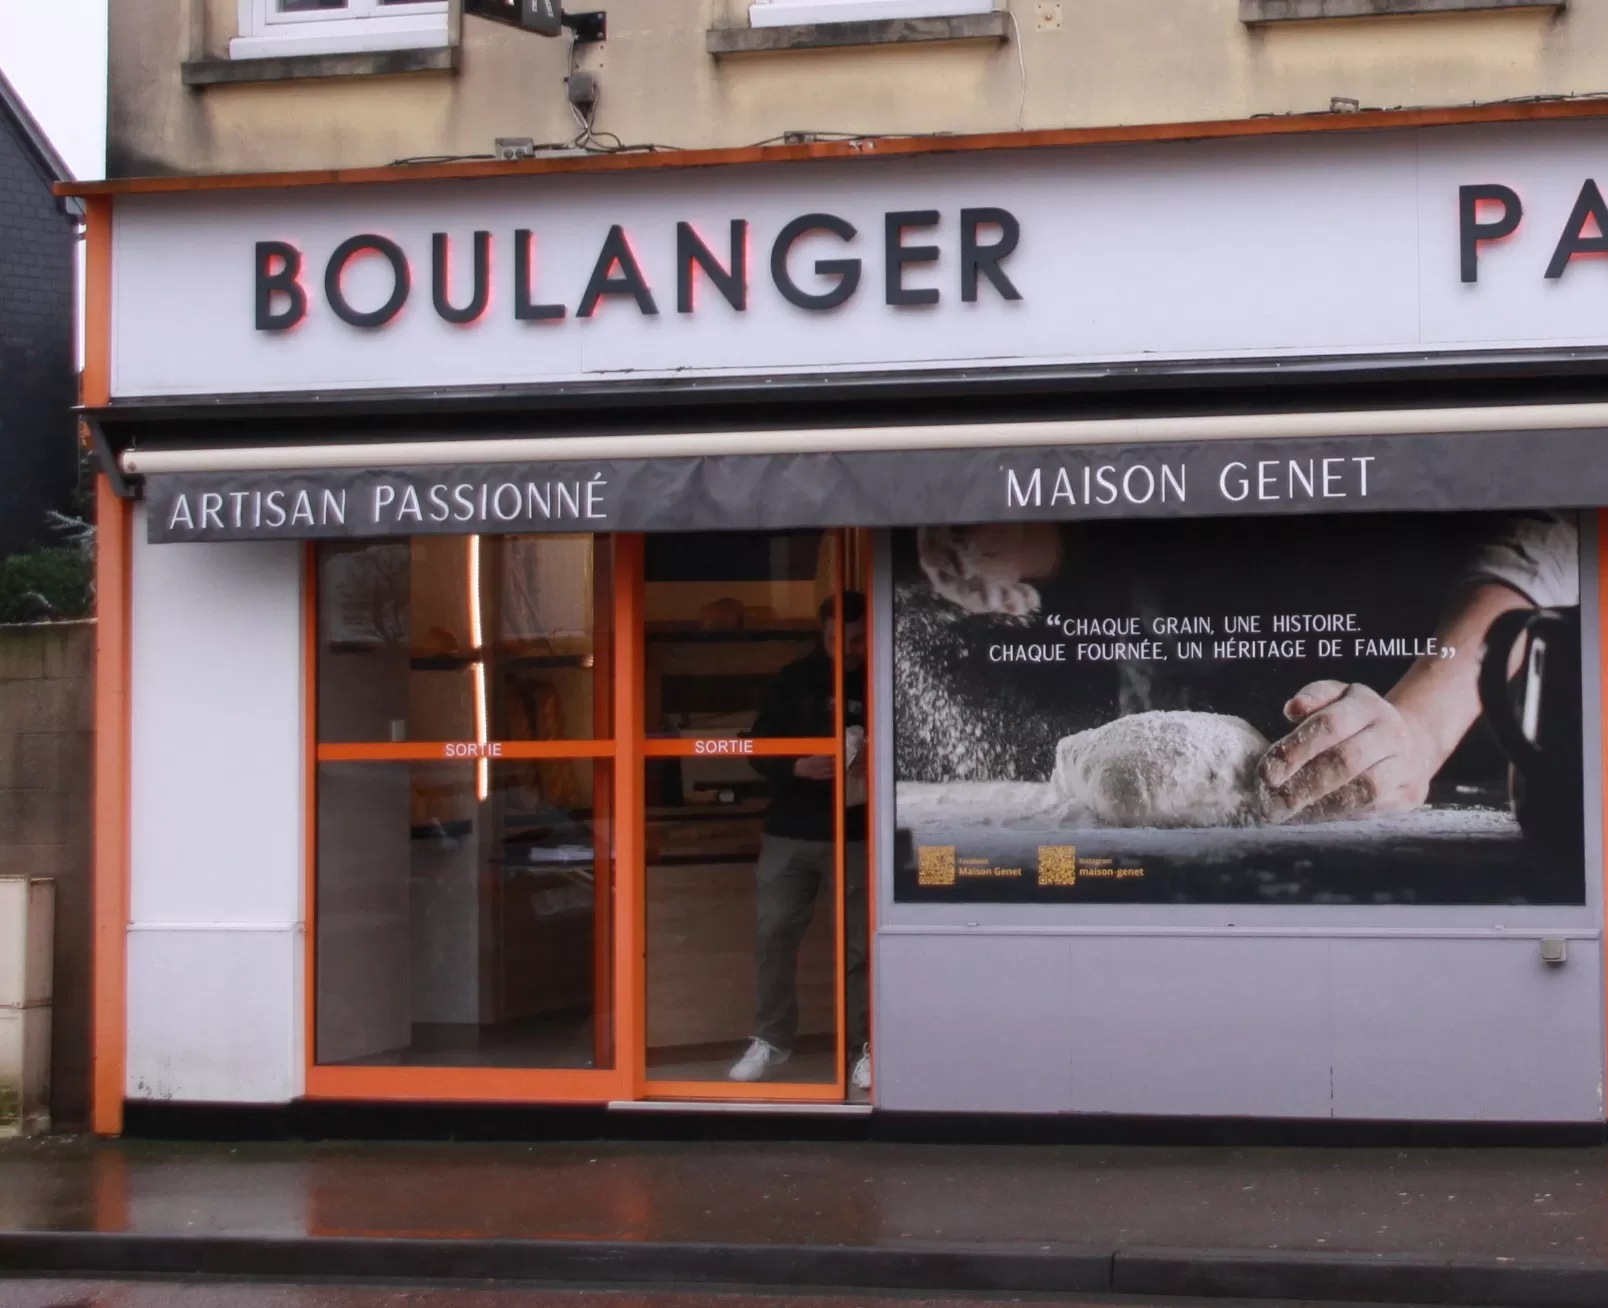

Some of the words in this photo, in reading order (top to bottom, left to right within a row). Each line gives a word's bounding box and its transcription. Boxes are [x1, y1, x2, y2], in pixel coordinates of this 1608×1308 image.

[253, 206, 1024, 331] BOULANGER
[1006, 463, 1187, 507] MAISON
[1219, 456, 1376, 501] GENET
[169, 488, 346, 530] ARTISAN
[373, 472, 608, 522] PASSIONNÉ
[1152, 616, 1215, 636] GRAIN,
[1224, 615, 1261, 634] UNE
[1273, 613, 1362, 633] HISTOIRE.
[989, 643, 1066, 662] CHAQUE
[1077, 638, 1168, 661] FOURNÉE,
[1177, 641, 1203, 659] UN
[1213, 637, 1306, 658] HÉRITAGE
[1318, 639, 1343, 657] DE
[444, 742, 502, 757] SORTIE
[694, 739, 753, 754] SORTIE
[958, 866, 992, 876] Maison
[994, 866, 1022, 876] Genet
